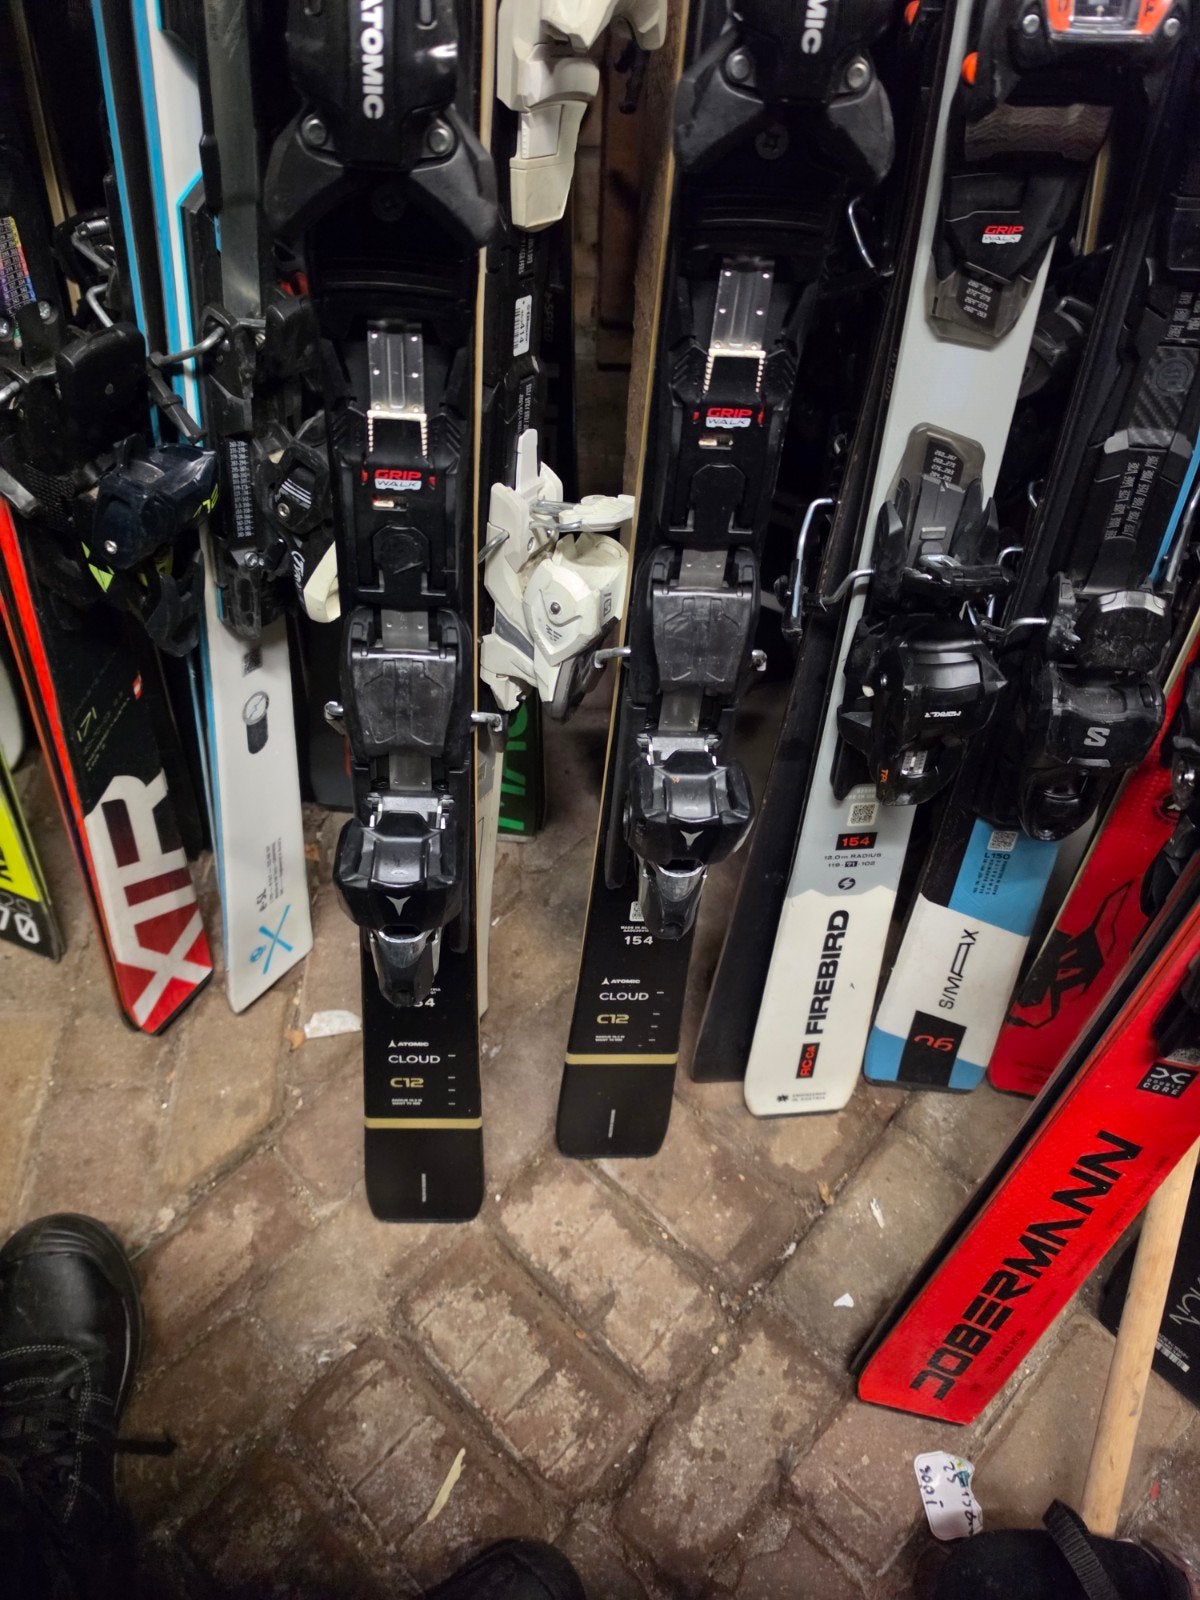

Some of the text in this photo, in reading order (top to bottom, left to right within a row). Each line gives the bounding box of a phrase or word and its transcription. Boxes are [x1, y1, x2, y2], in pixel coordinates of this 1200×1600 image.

[984, 225, 1024, 235] GRIP
[706, 407, 753, 418] GRIP
[374, 468, 422, 480] GRIP
[376, 480, 417, 488] WALK
[841, 836, 871, 847] 154
[624, 936, 654, 946] 154
[805, 909, 850, 1035] FIREBIRD
[599, 992, 649, 1001] CLOUD
[596, 1013, 630, 1024] C12
[388, 1054, 441, 1064] CLOUD
[390, 1077, 424, 1088] C12
[1142, 1082, 1179, 1096] CORE
[909, 1129, 1144, 1401] DOBERMANN
